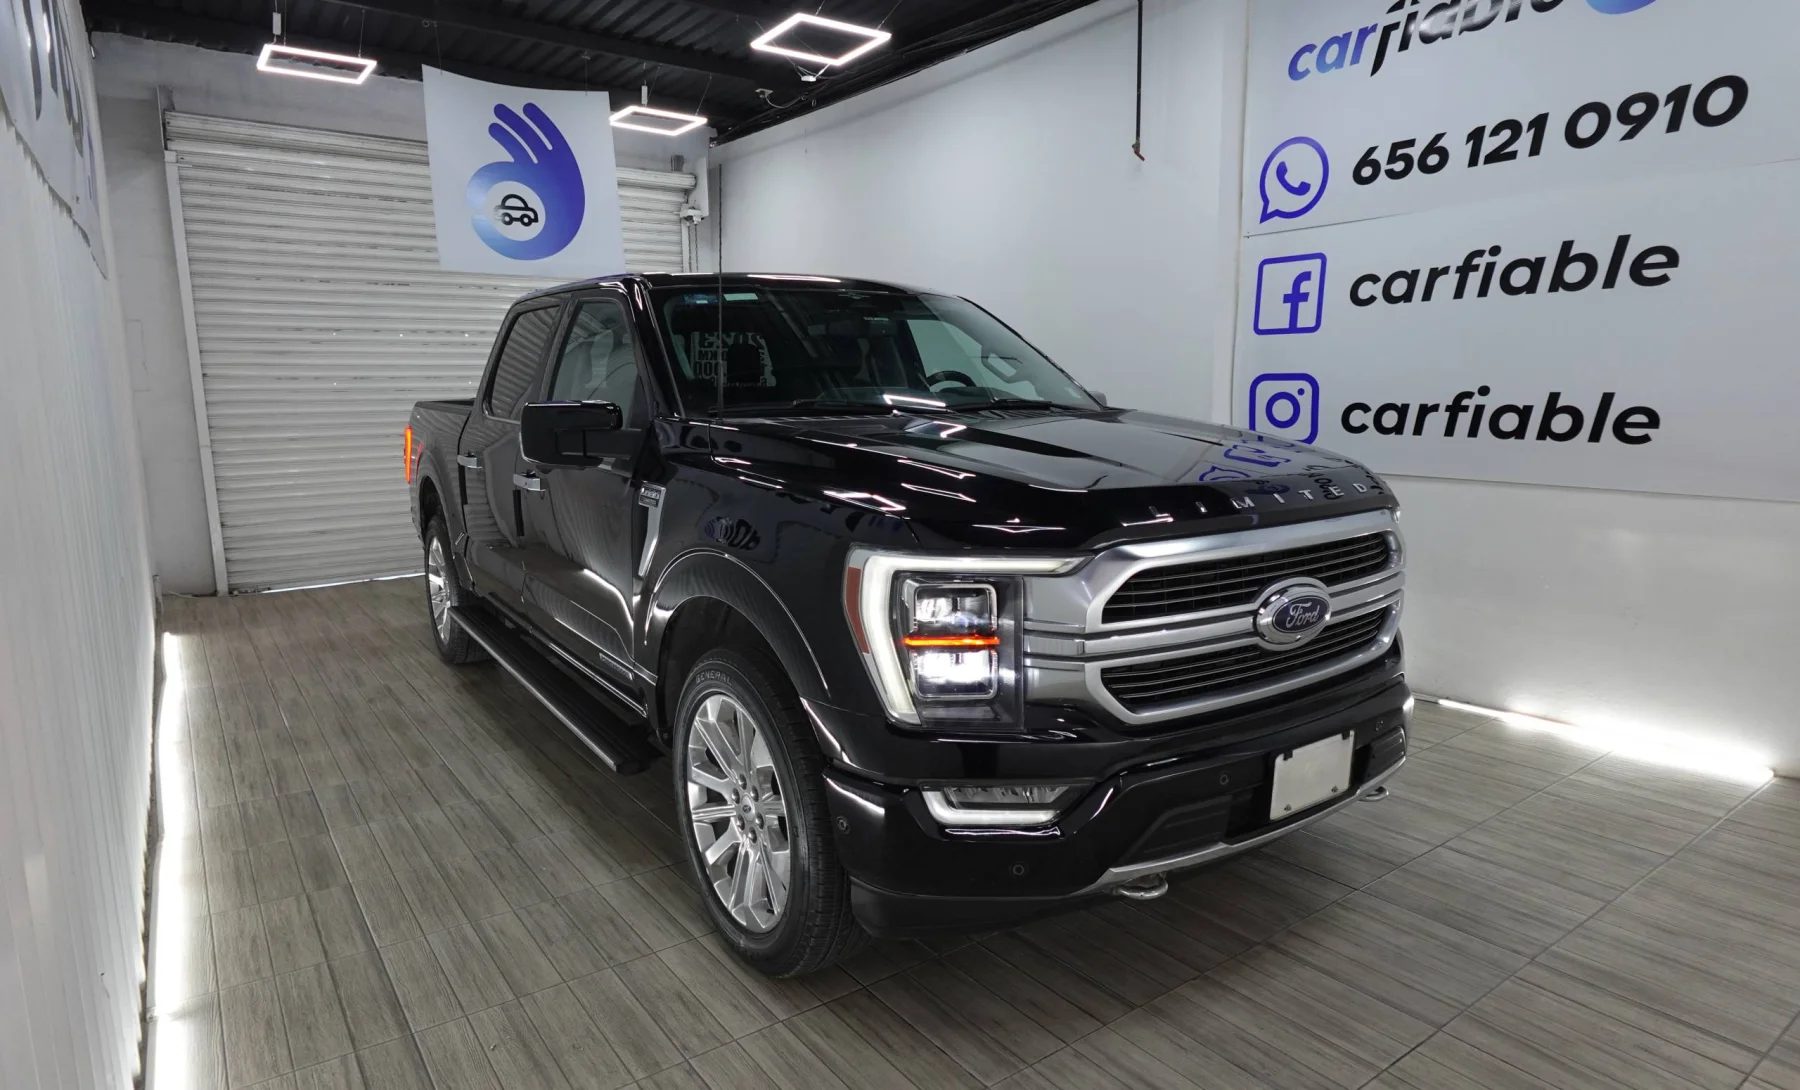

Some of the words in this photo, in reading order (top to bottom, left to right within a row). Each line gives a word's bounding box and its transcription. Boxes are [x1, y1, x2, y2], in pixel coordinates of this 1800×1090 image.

[1352, 132, 1450, 186] 656
[1465, 112, 1550, 169] 121
[1564, 75, 1749, 150] 0910
[1349, 234, 1680, 307] carfiable
[1340, 385, 1661, 446] carfiable
[1149, 483, 1367, 517] LIMITED
[1286, 601, 1320, 628] Ford
[695, 670, 732, 685] GENERAL
